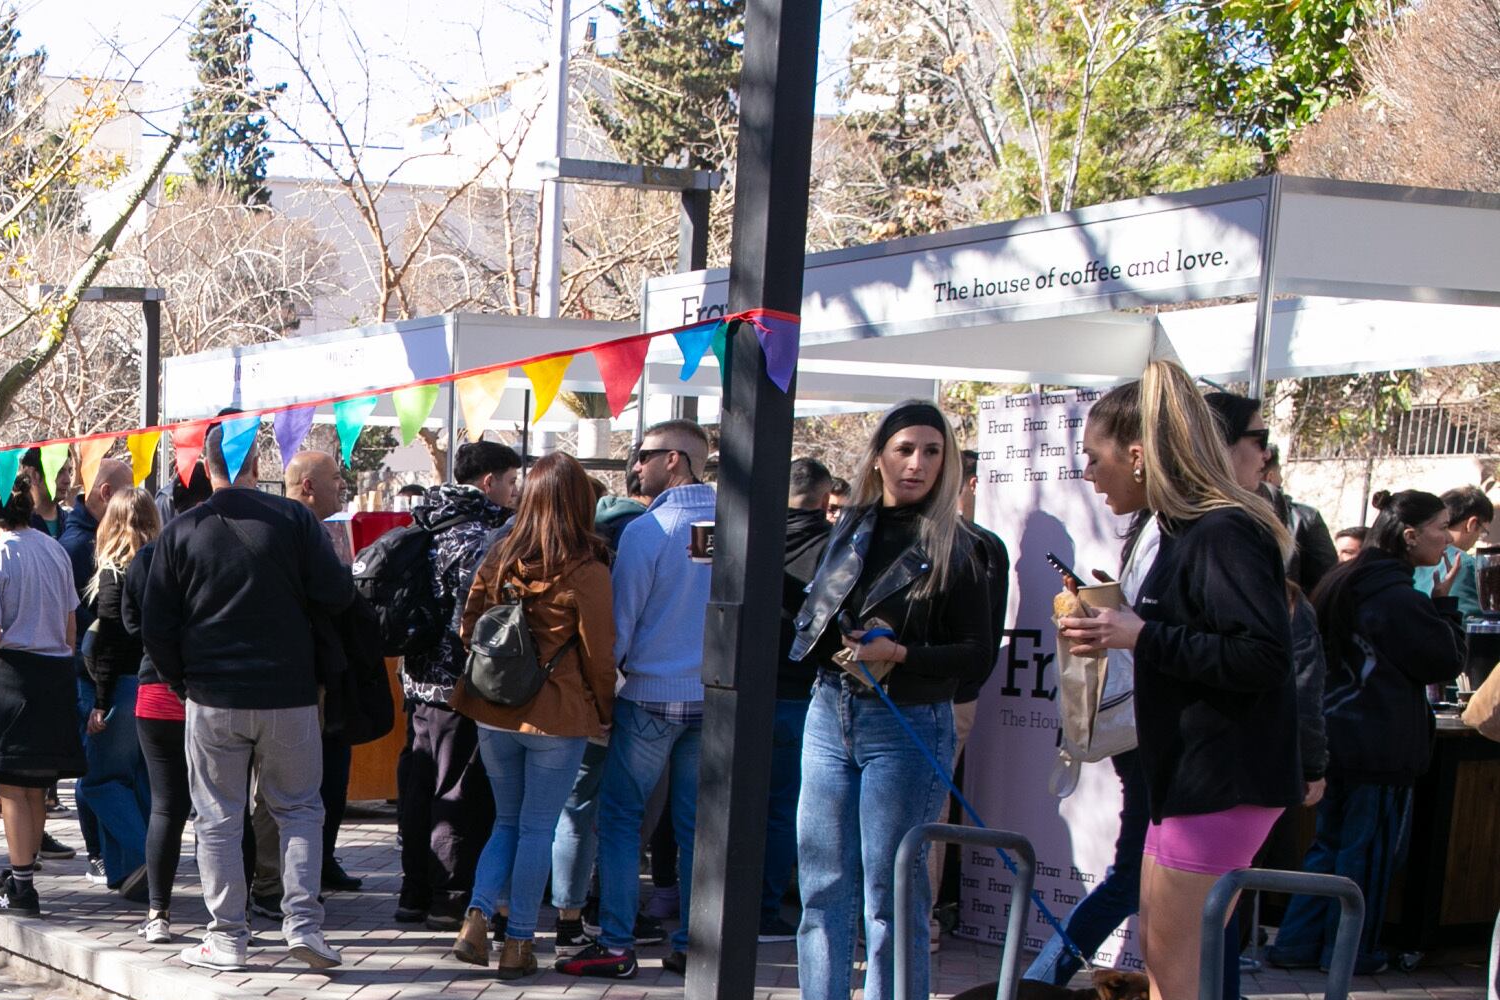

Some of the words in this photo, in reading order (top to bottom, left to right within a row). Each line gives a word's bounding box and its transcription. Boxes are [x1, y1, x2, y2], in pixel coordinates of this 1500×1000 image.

[933, 281, 969, 303] The
[973, 277, 1030, 298] house
[1035, 266, 1056, 289] of
[1060, 260, 1121, 286] coffee
[1127, 252, 1170, 278] and
[1175, 249, 1229, 272] love.
[681, 295, 729, 326] Fra
[1004, 394, 1030, 409] Fran
[1040, 391, 1066, 406] Fran
[988, 420, 1013, 434] Fran
[1023, 418, 1048, 432] Fran
[1058, 415, 1083, 429] Fran
[1006, 445, 1031, 459] Fran
[1040, 443, 1066, 457] Fran
[989, 469, 1013, 484] Fran
[1024, 467, 1048, 482] Fran
[1058, 466, 1083, 480] Fran
[1000, 709, 1027, 727] The
[1030, 711, 1059, 729] Hou
[971, 851, 995, 868] Fran
[1035, 861, 1060, 878] Fran
[1070, 866, 1095, 883] Fran
[972, 898, 995, 915] Fran
[987, 925, 1007, 941] Fra
[1023, 932, 1044, 949] ran
[1122, 952, 1145, 970] Fra
